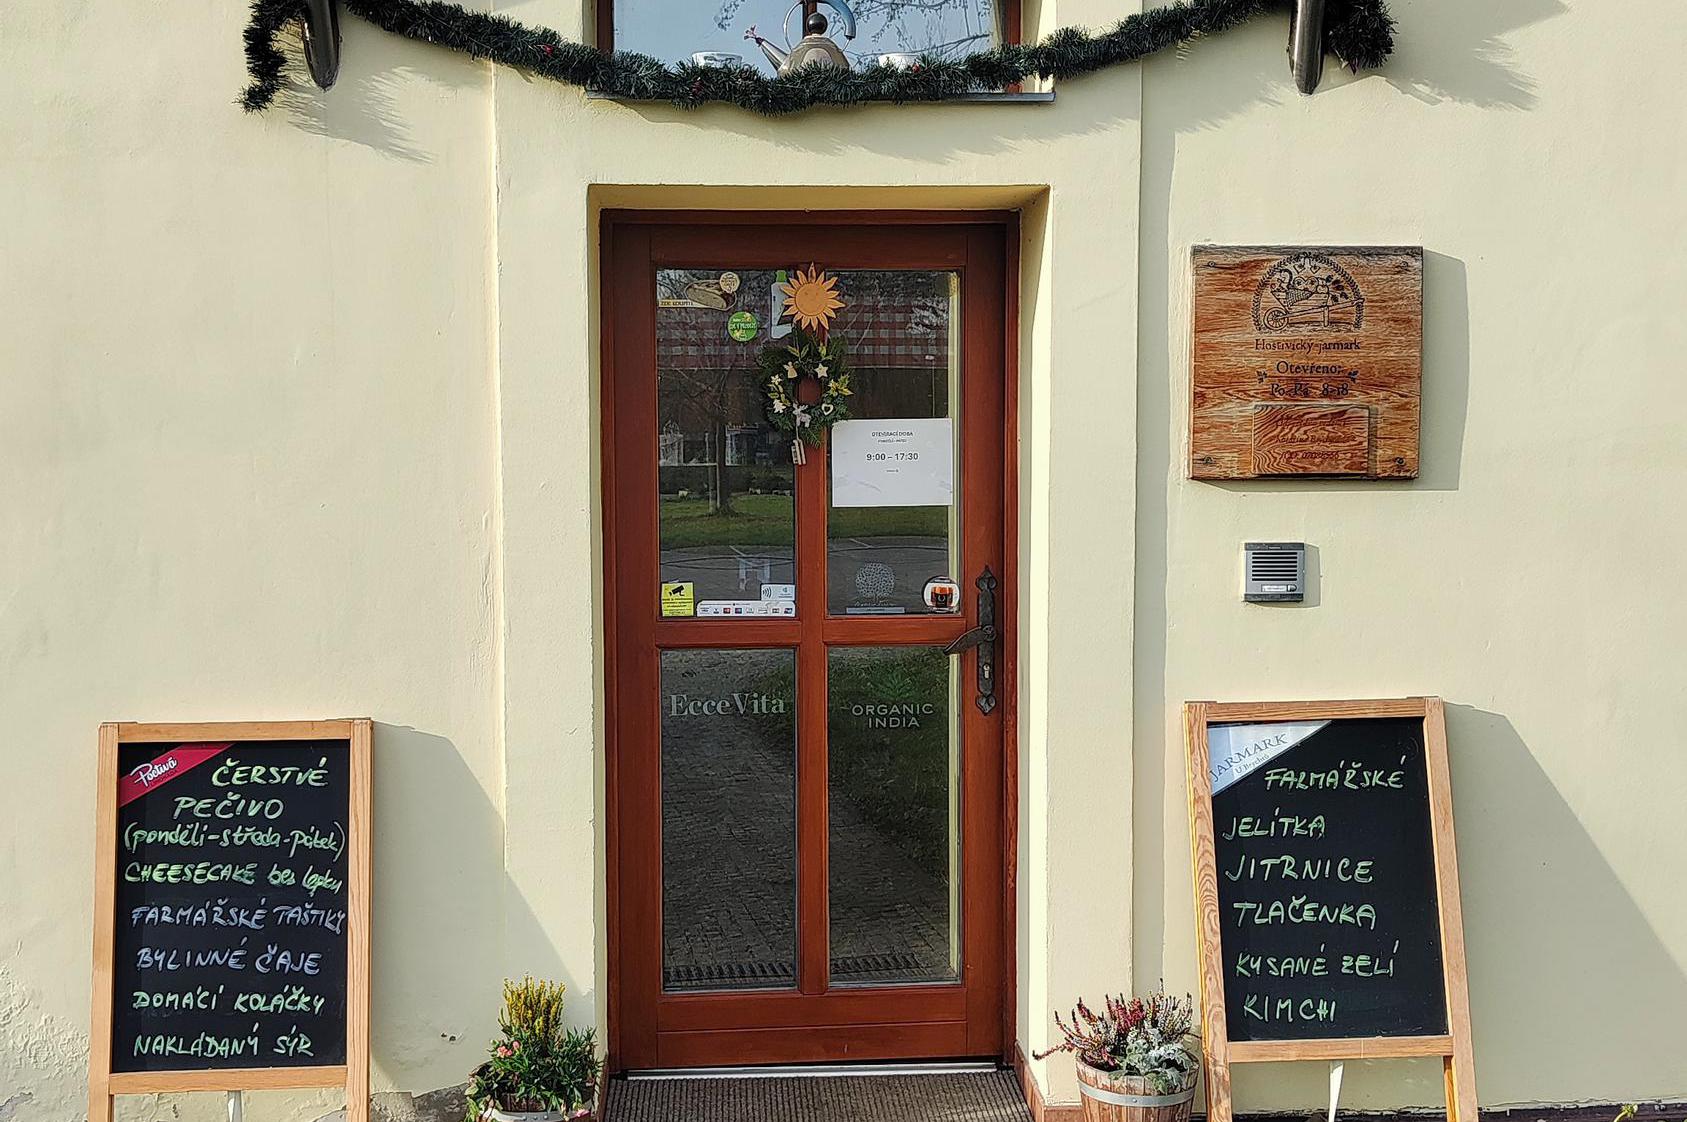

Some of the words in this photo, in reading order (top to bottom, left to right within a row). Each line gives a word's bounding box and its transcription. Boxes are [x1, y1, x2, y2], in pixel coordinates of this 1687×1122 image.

[1317, 338, 1360, 354] jarmark
[866, 453, 886, 461] 9:00
[894, 452, 919, 461] 17:30
[851, 703, 934, 716] ORGANIC
[868, 716, 920, 728] INDIA
[129, 757, 178, 788] Poctivá
[211, 757, 329, 787] ČERSTVÉ
[1209, 733, 1288, 782] JARMARK
[1264, 755, 1407, 791] FARMÁŘSKÉ
[173, 791, 285, 820] PEČIVO
[1222, 807, 1326, 840] JELÍTKA
[124, 861, 258, 885] CHEESECAKE
[1225, 854, 1375, 883] JITRNICE
[131, 897, 268, 930] FARMÁŘSKÉ
[1233, 895, 1377, 930] TLAČENKA
[136, 936, 248, 972] BYLINNÉ
[255, 943, 323, 975] ČAJE
[1341, 939, 1400, 977] ZELÍ
[132, 984, 225, 1011] DOMÁCÍ
[234, 984, 326, 1015] KOLÁČKY
[1243, 993, 1337, 1023] KIMCHI
[133, 1022, 260, 1059] NAKLÁDANÝ
[273, 1025, 315, 1057] SÝR
